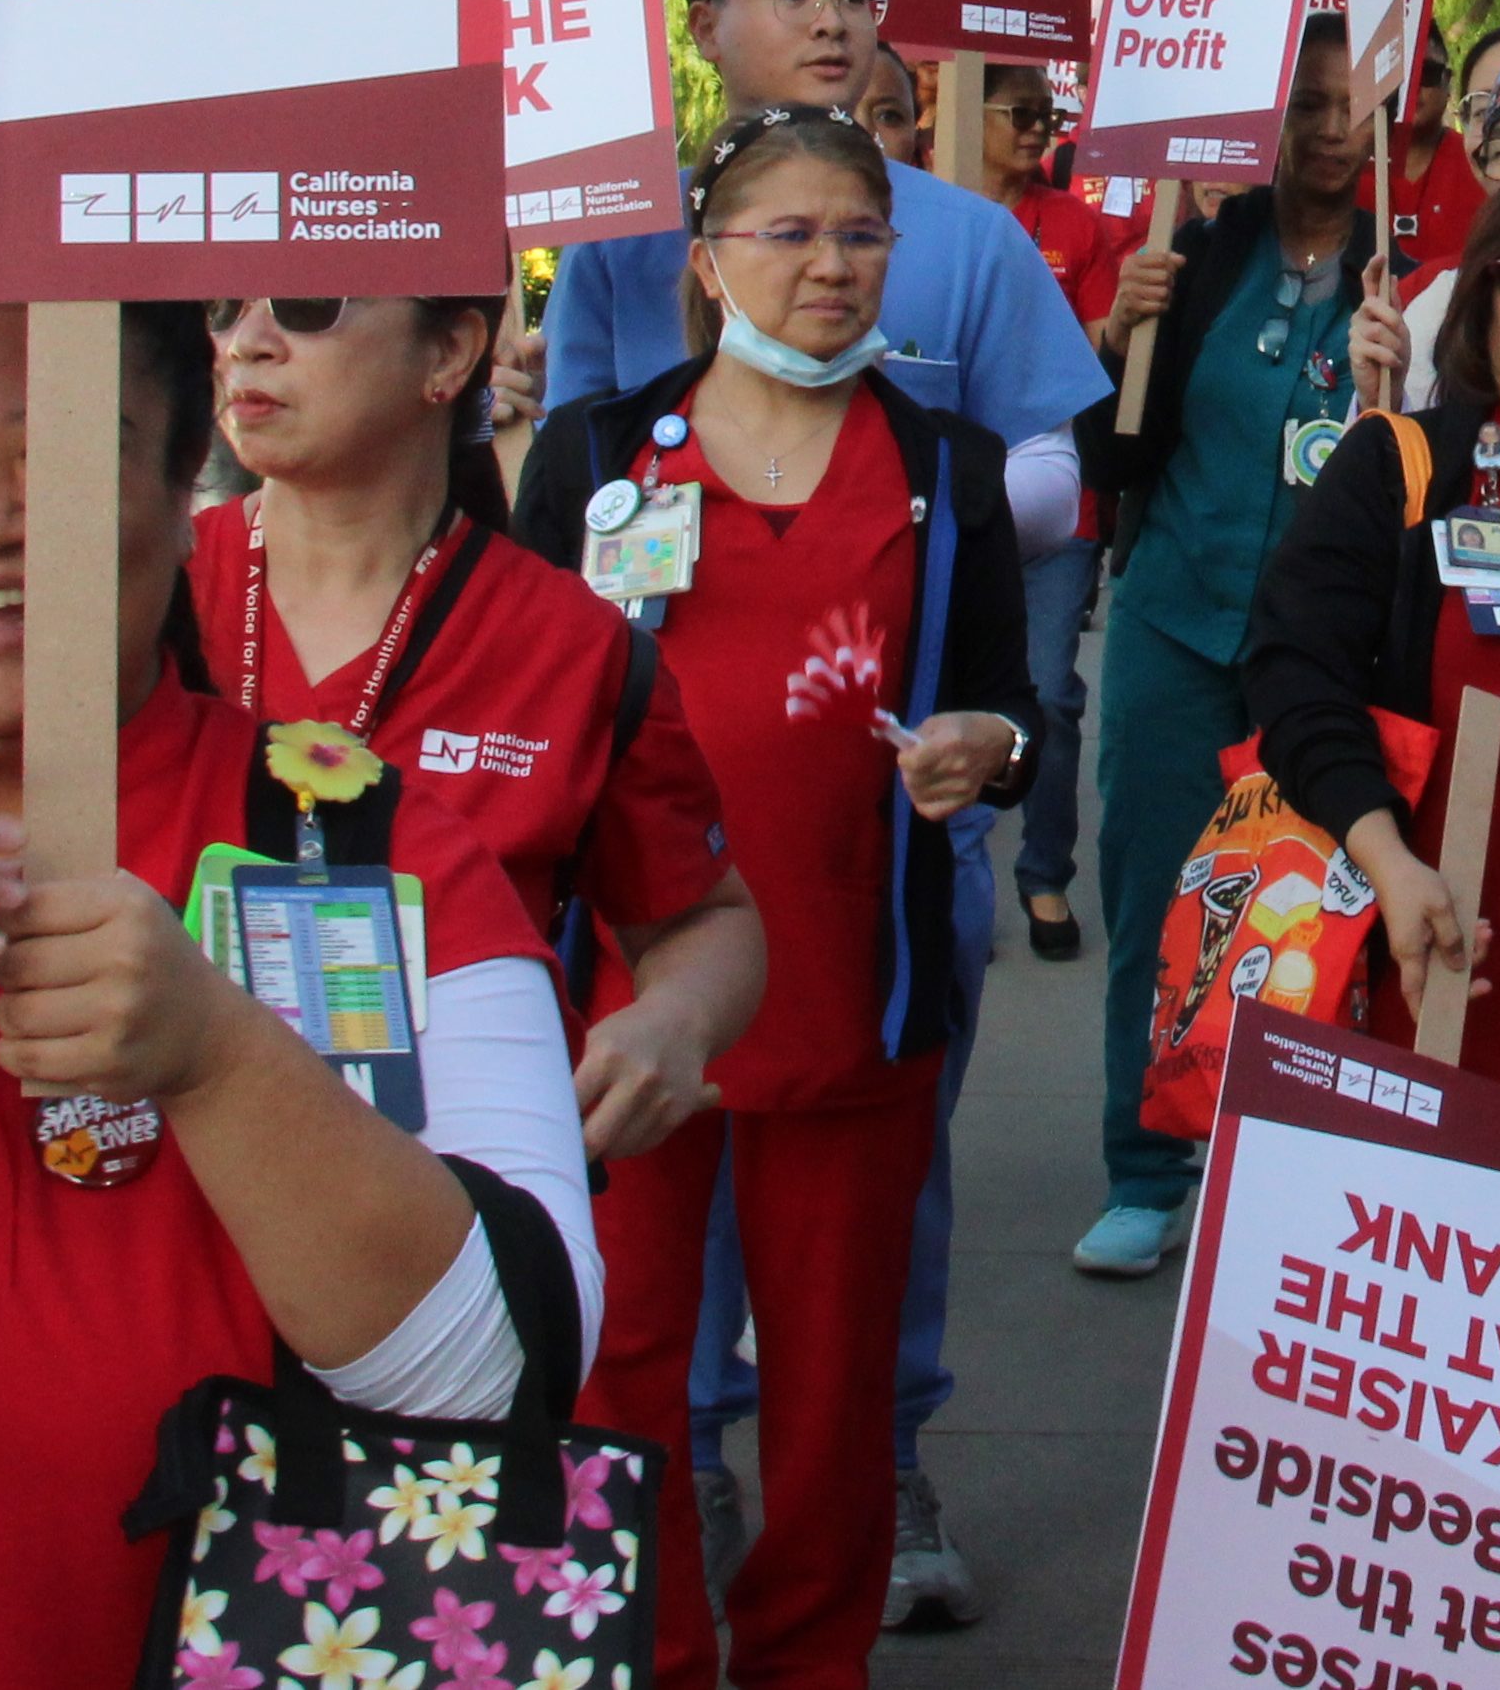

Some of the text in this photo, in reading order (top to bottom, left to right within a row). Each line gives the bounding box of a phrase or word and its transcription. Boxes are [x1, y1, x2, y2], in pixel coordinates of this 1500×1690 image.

[1028, 11, 1066, 25] California
[1028, 21, 1055, 33] Nurses
[1027, 30, 1074, 43] Association
[1114, 27, 1227, 71] Profit
[289, 170, 415, 195] California
[584, 178, 640, 196] California
[290, 196, 379, 217] Nurses
[585, 192, 625, 207] Nurses
[585, 198, 653, 218] Association
[289, 218, 441, 241] Association
[241, 564, 260, 709] A Voice for Nur
[349, 700, 370, 728] for
[483, 731, 549, 752] National
[481, 744, 534, 765] Nurses
[479, 757, 532, 778] United
[1262, 1030, 1337, 1064] Association
[1272, 1060, 1333, 1091] California
[1291, 1053, 1335, 1079] Nurses
[1273, 1253, 1429, 1359] THE
[1287, 1543, 1415, 1634] the
